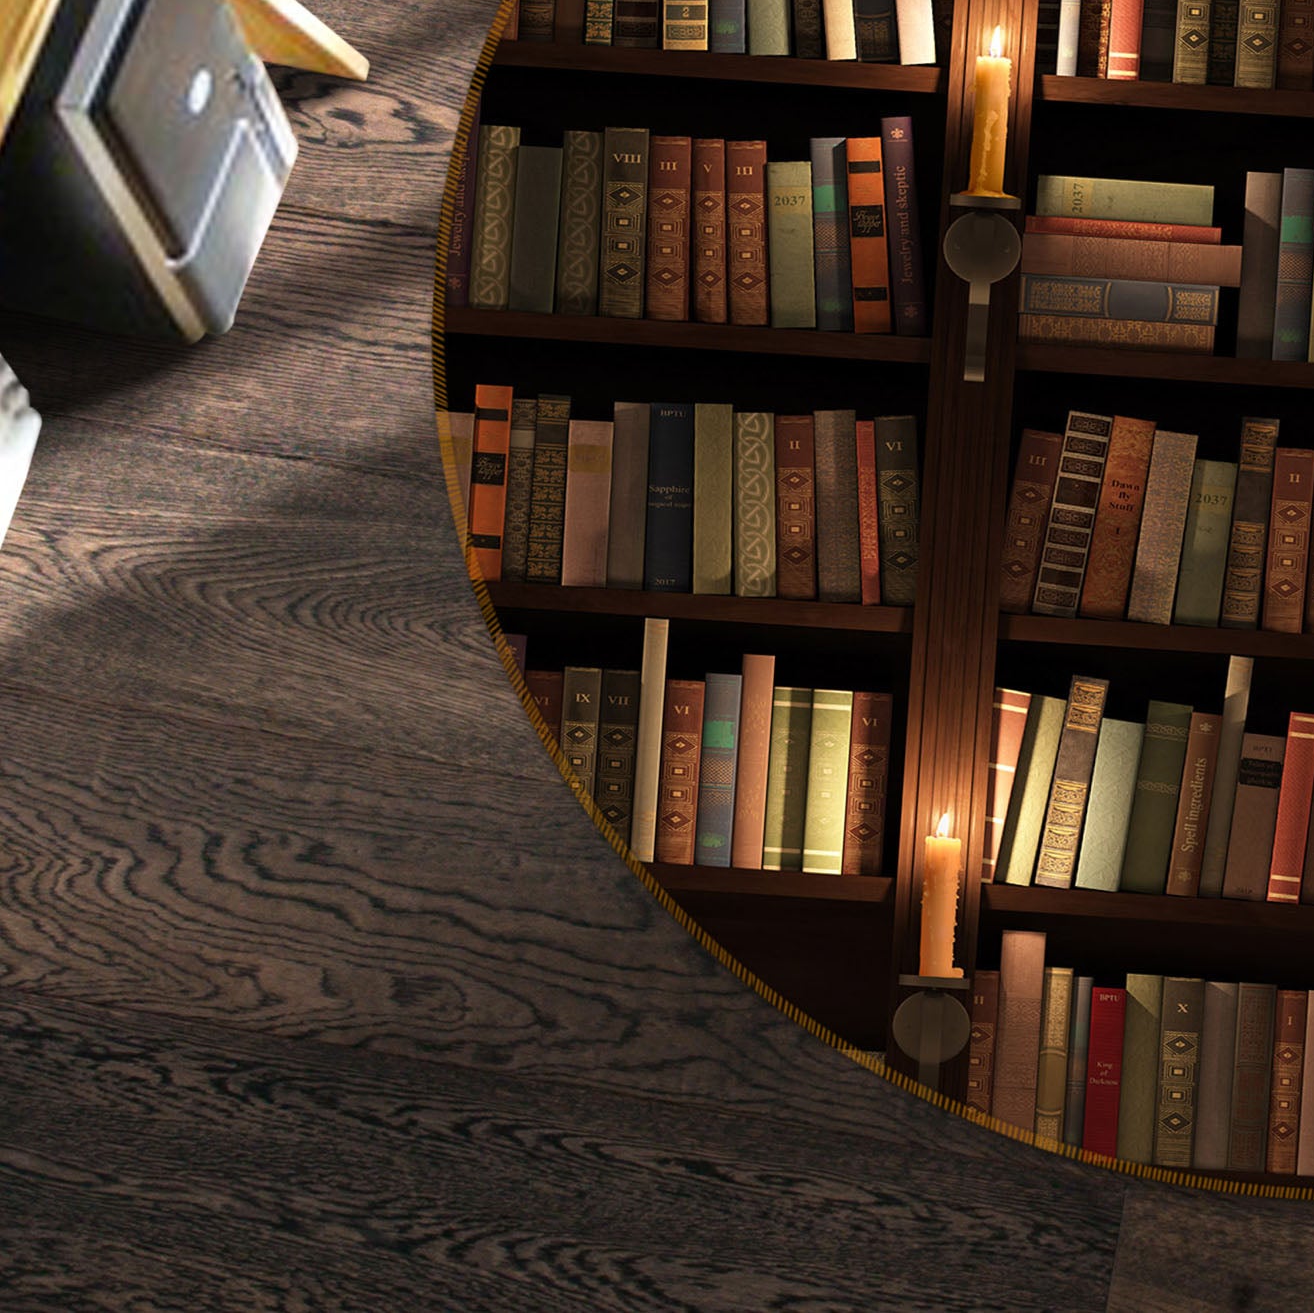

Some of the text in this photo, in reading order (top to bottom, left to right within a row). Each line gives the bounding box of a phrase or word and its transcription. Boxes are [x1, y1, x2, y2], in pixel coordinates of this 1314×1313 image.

[613, 153, 641, 164] VIII
[659, 161, 678, 171] III
[703, 165, 712, 173] V
[735, 166, 753, 175] III
[893, 165, 910, 209] skeptic
[774, 196, 805, 206] 2037
[1072, 183, 1084, 213] 2037
[789, 441, 800, 449] II
[885, 442, 902, 451] VI
[1289, 474, 1300, 483] II
[649, 485, 690, 495] Sapphire
[1195, 494, 1228, 505] 2037
[575, 694, 590, 703] IX
[608, 696, 629, 705] VII
[674, 706, 689, 715] VI
[863, 718, 877, 726] VI
[1181, 757, 1207, 852] Spell ingredients
[1178, 1004, 1188, 1013] X
